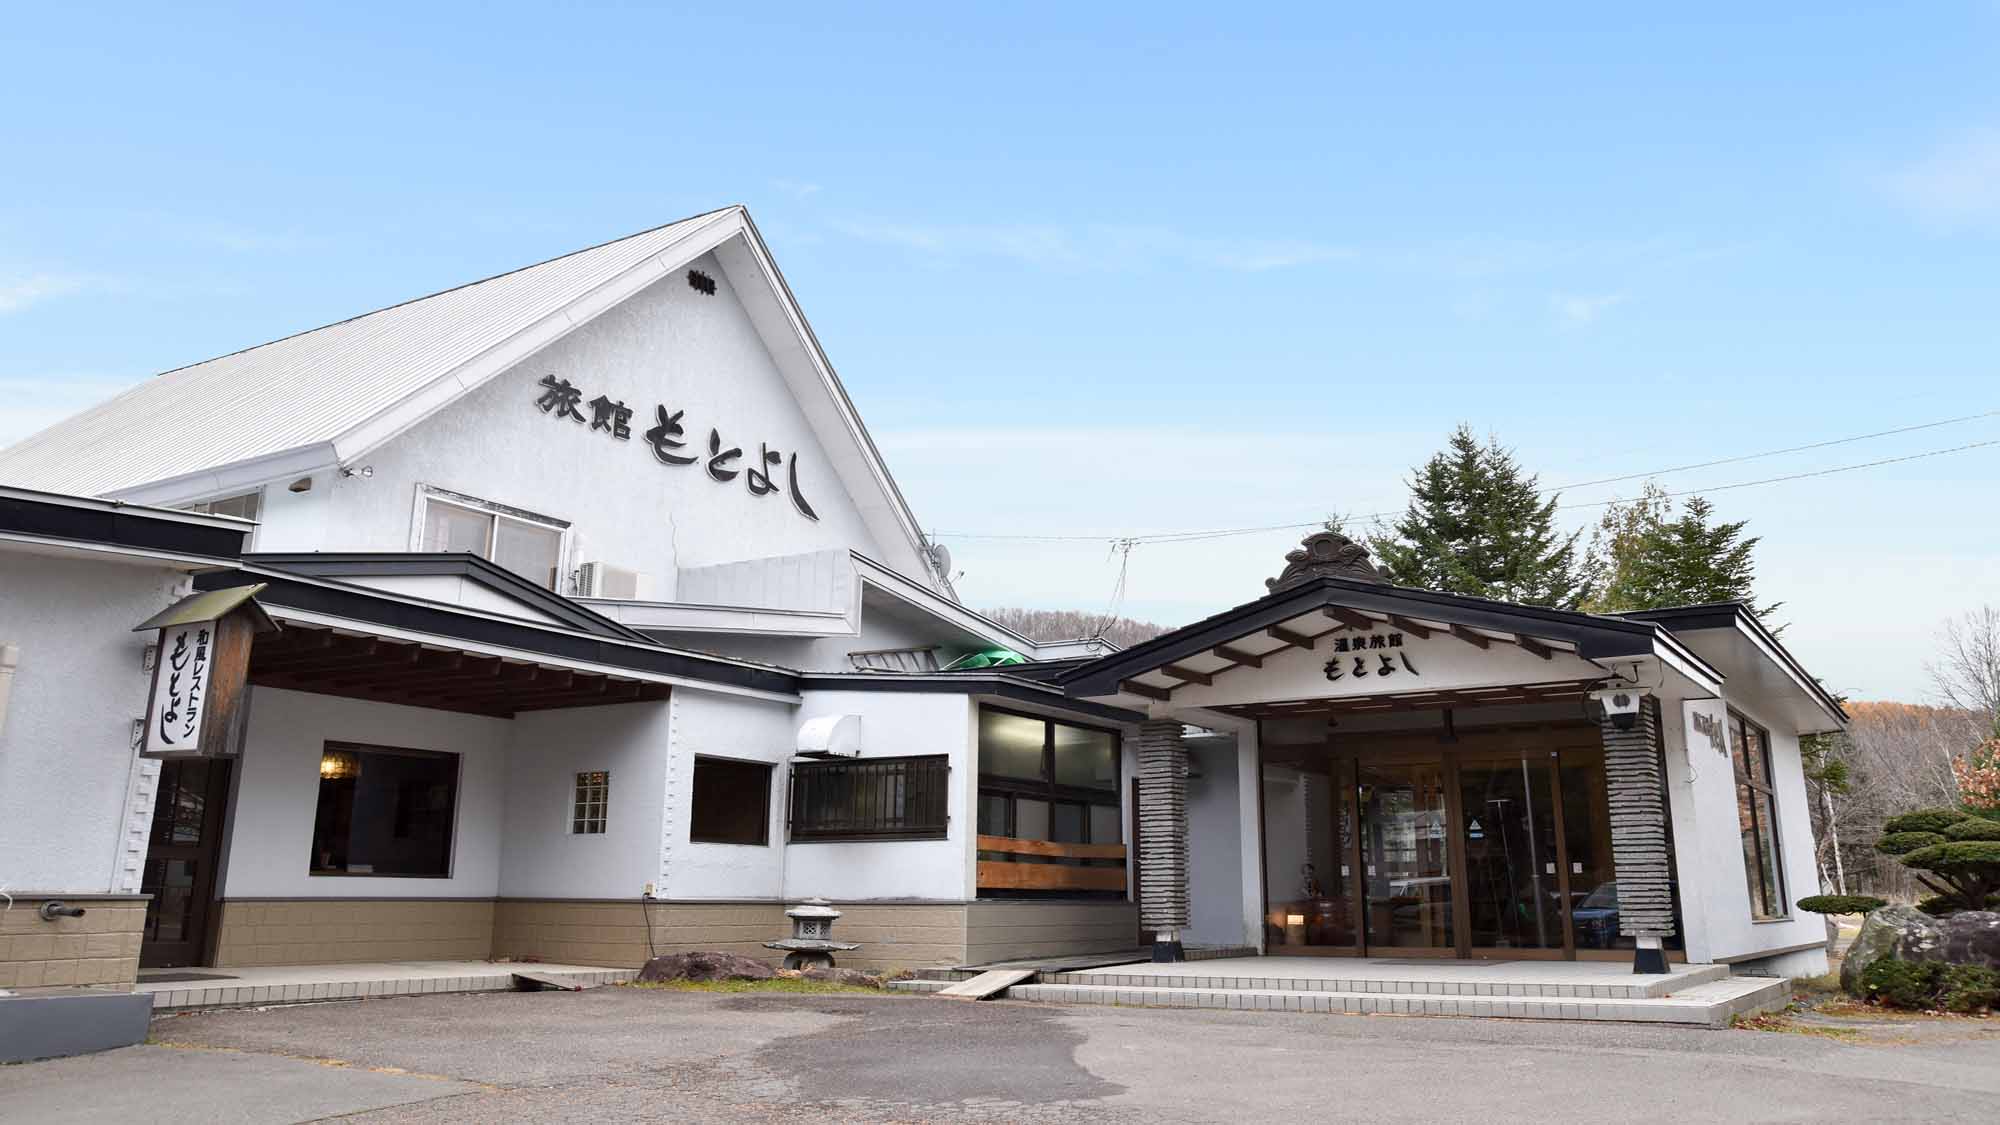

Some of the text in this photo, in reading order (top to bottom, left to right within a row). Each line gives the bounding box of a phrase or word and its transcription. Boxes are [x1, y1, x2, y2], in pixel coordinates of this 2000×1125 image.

[1323, 651, 1419, 681] もとよし
[1334, 633, 1403, 652] 温泉旅館
[160, 631, 190, 744] もとよし
[183, 628, 209, 738] 和風レストラン
